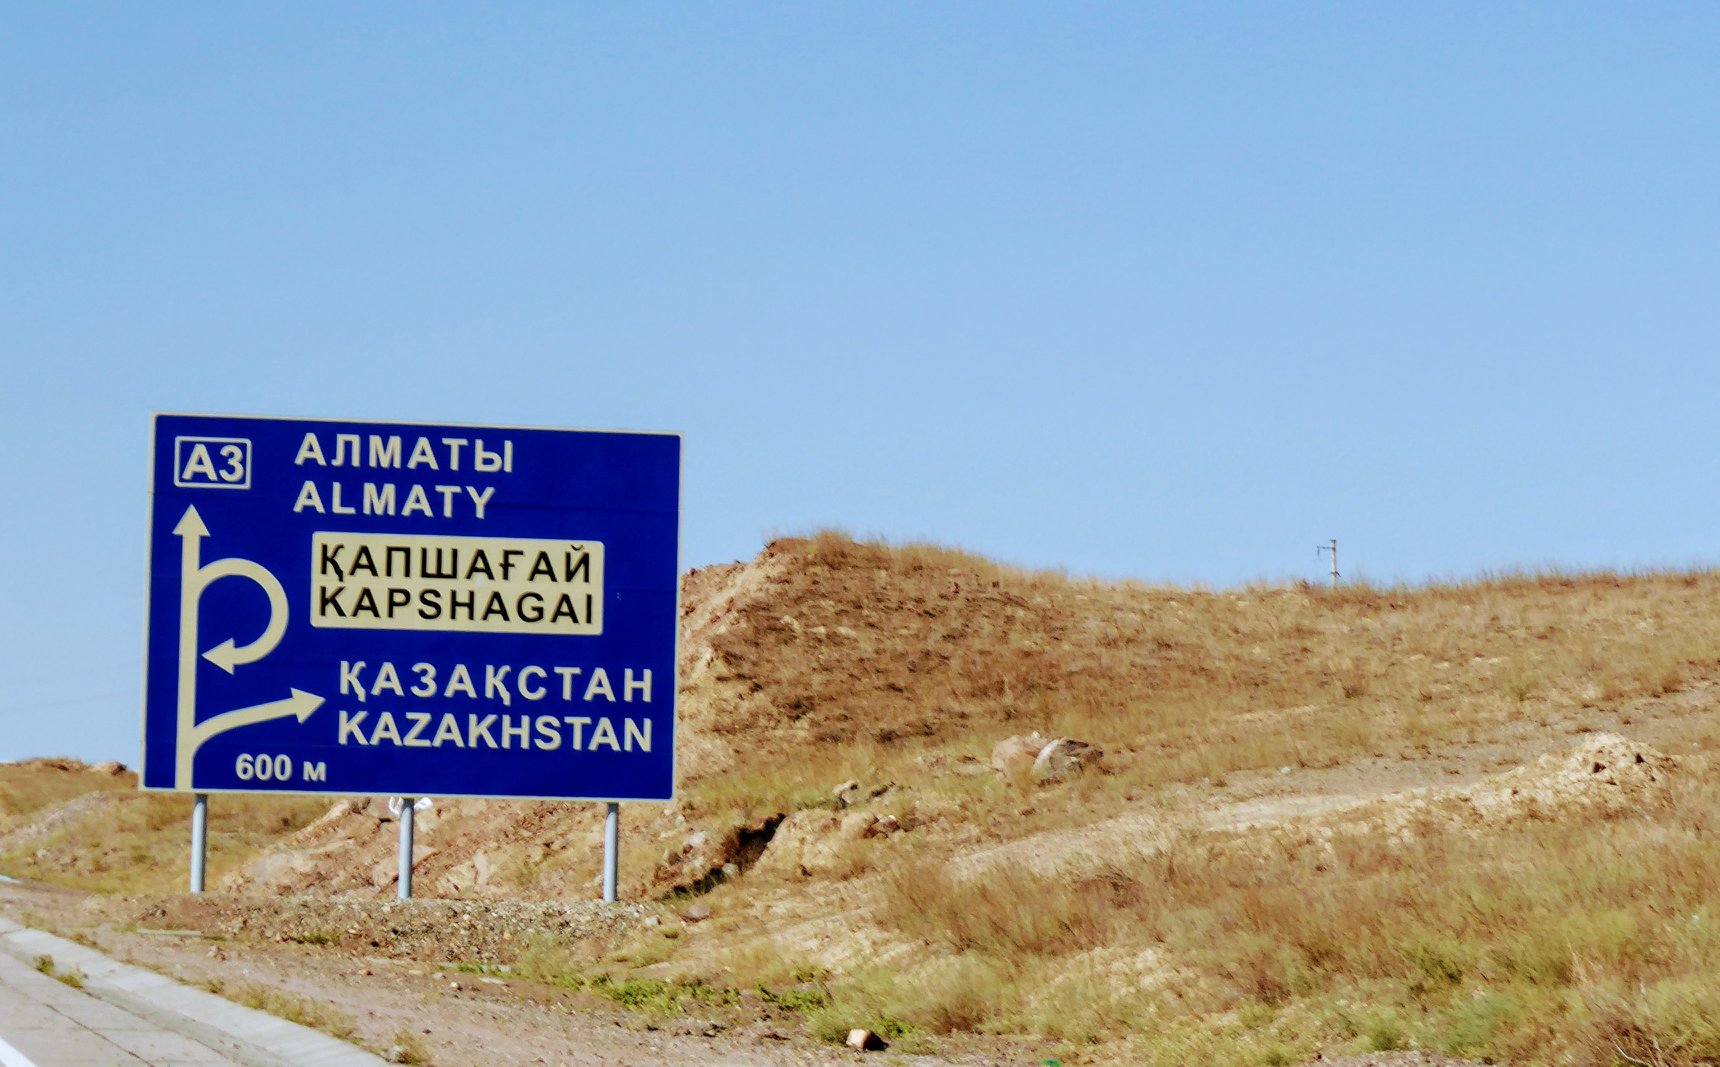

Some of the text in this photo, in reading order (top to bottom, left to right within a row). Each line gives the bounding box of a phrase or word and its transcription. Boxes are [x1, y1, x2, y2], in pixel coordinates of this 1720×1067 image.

[294, 432, 514, 473] АЛМАТЫ
[293, 480, 495, 519] ALMATY
[319, 543, 592, 584] ҚАПШАҒАЙ
[318, 585, 594, 626] KAPSHAGAI
[339, 660, 653, 706] ҚАЗАҚСТАН
[338, 710, 653, 752] KAZAKHSTAN
[235, 753, 292, 781] 600
